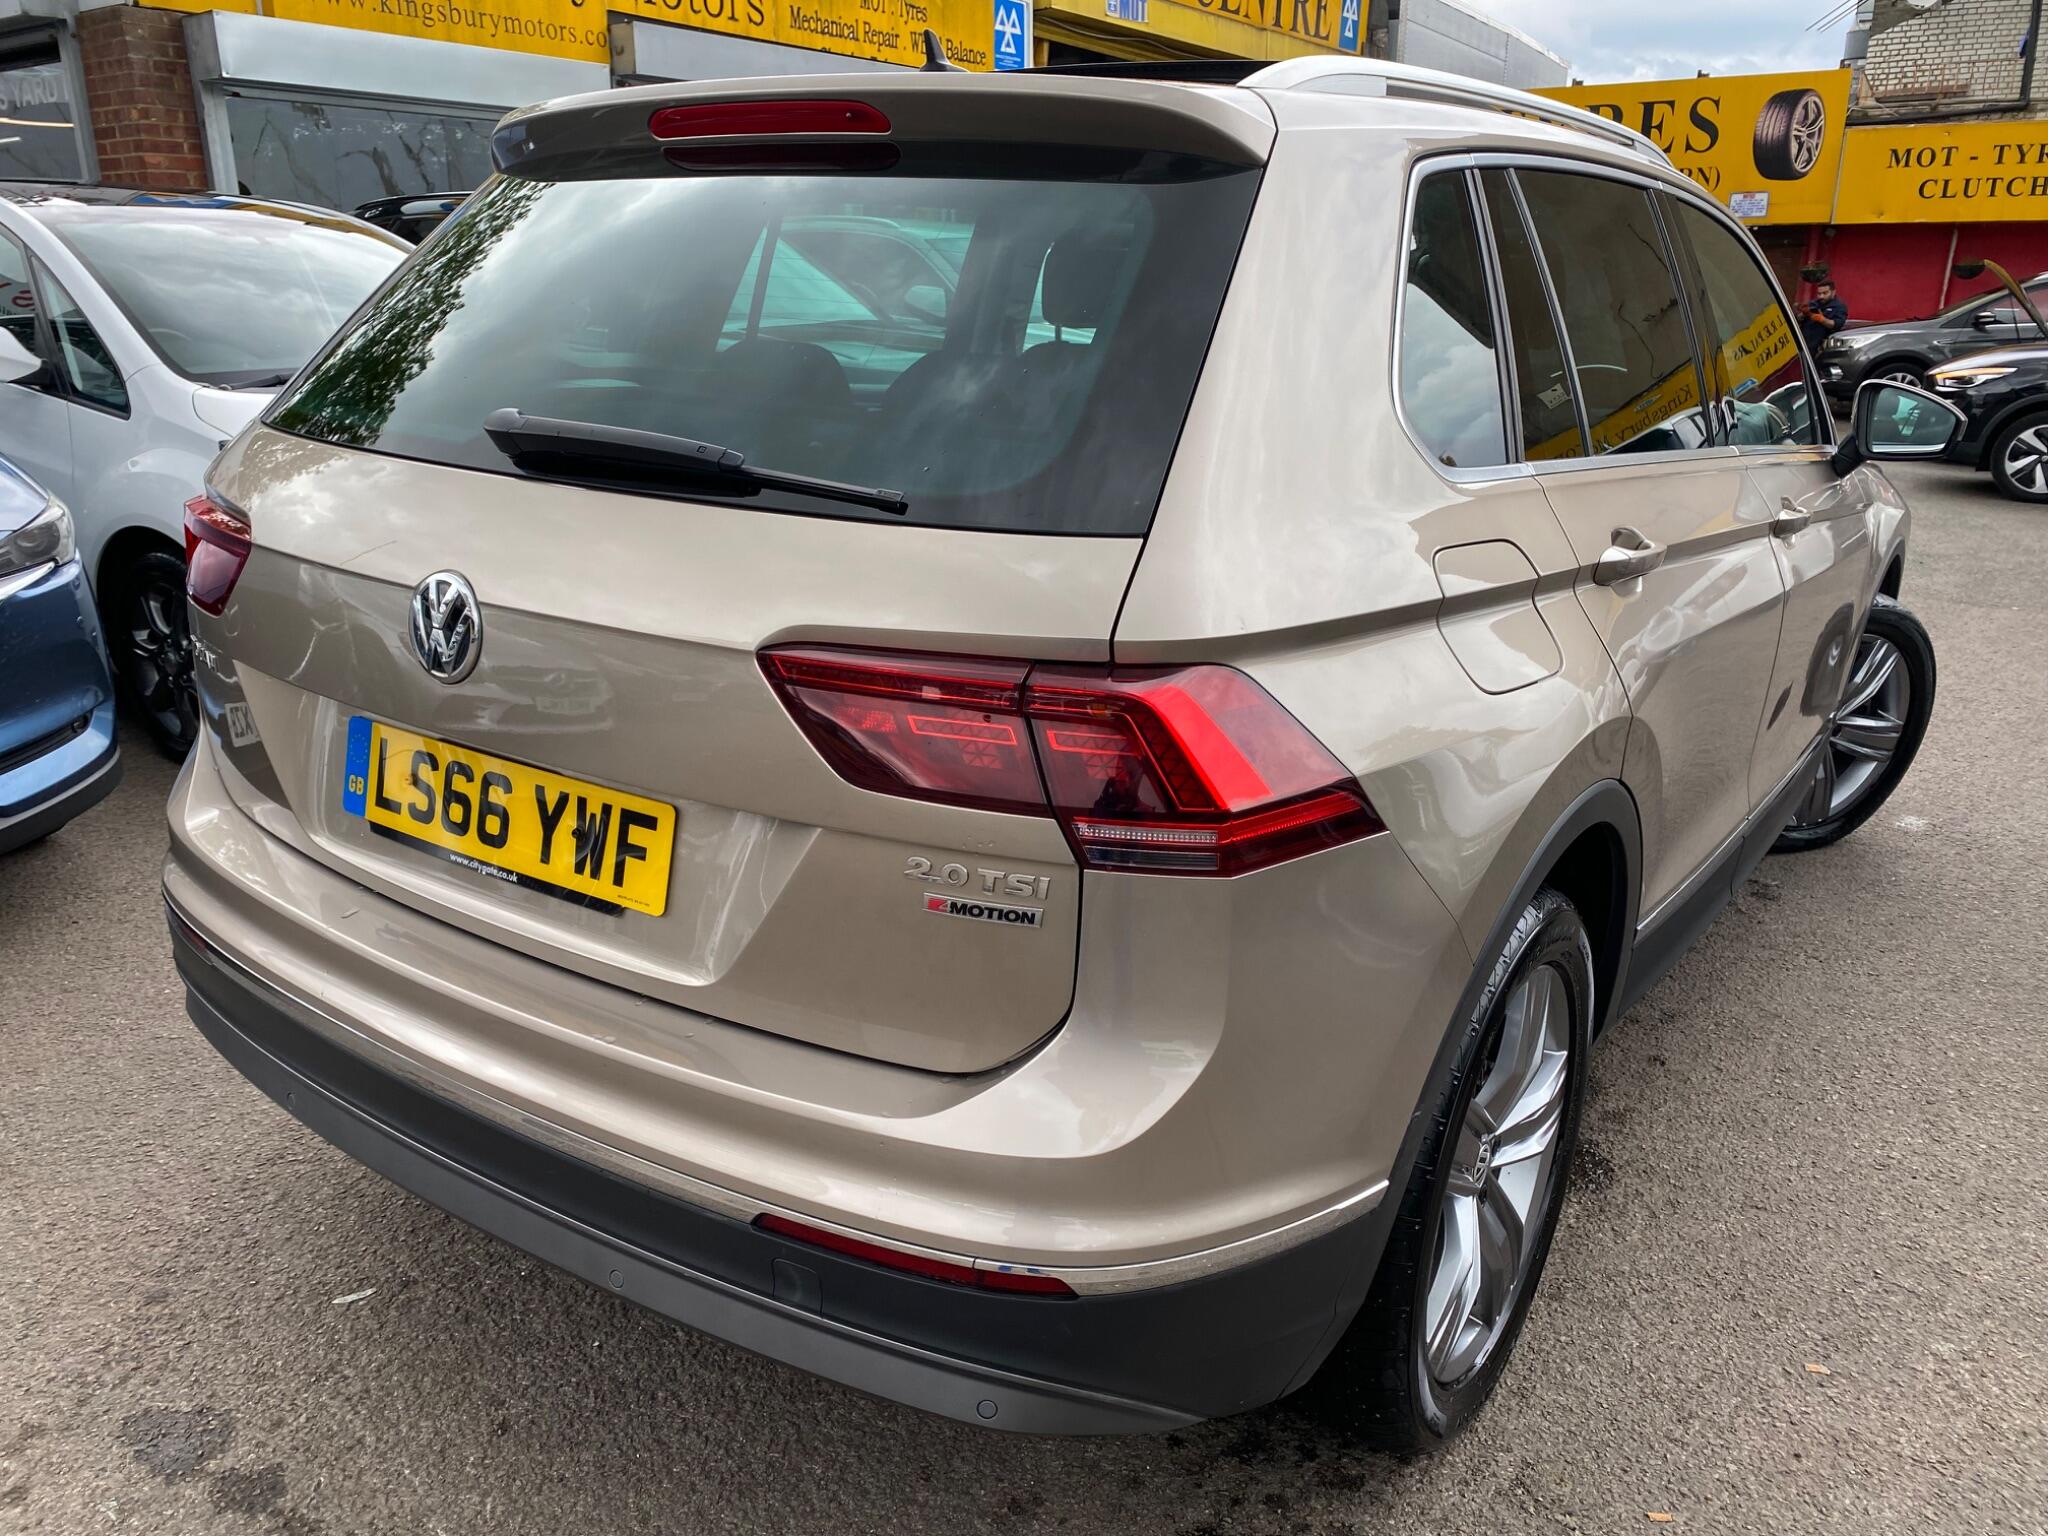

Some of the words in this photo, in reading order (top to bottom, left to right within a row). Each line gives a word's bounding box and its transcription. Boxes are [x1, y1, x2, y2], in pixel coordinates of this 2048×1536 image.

[897, 0, 928, 25] Tyres
[789, 5, 859, 41] Mechanical
[863, 21, 900, 52] Repair
[946, 38, 986, 66] Balance
[1887, 146, 1959, 169] MOT
[1918, 176, 2048, 199] CLUTCH
[348, 774, 364, 796] GB
[375, 737, 513, 849] LS66
[535, 784, 658, 887] YWF
[450, 853, 518, 883] www.citygate.co.uk
[904, 856, 969, 888] 2.0
[977, 868, 1051, 900] TSI
